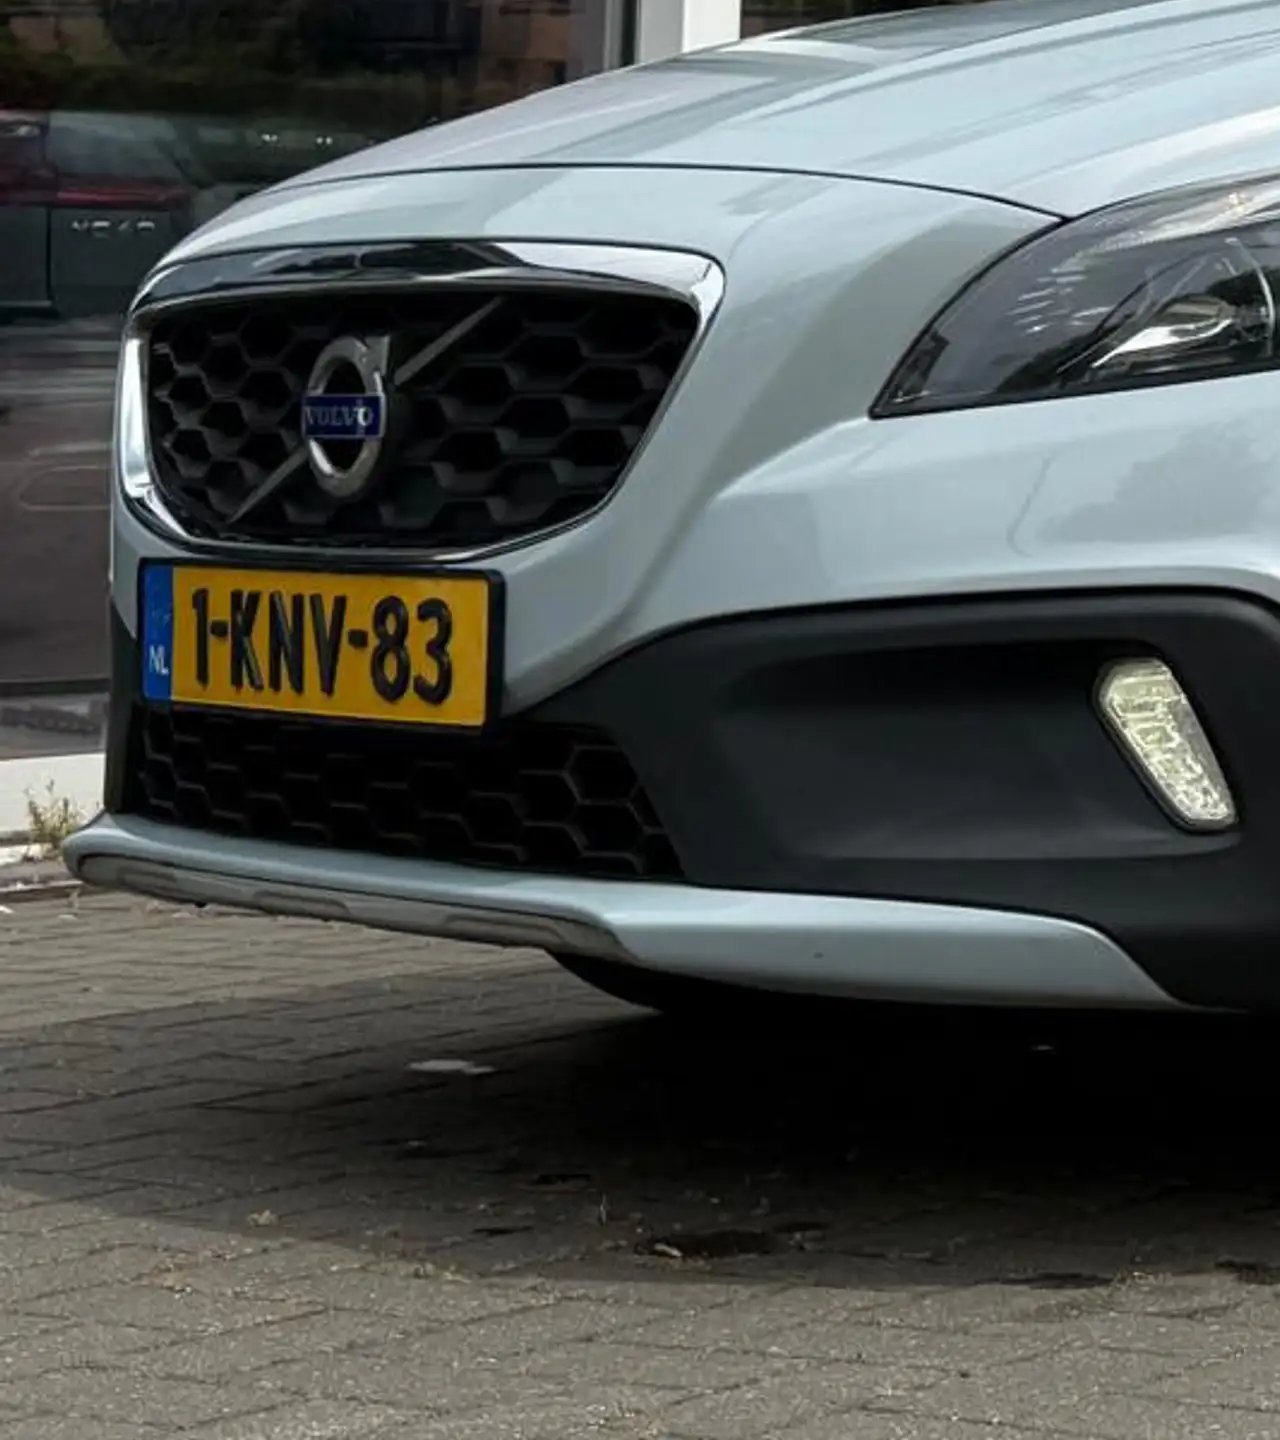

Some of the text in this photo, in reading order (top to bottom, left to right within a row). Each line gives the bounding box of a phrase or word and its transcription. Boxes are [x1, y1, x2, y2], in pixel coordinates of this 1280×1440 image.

[303, 406, 375, 427] VOLVO
[148, 643, 170, 676] NL
[192, 587, 454, 706] 1-KNV-83
